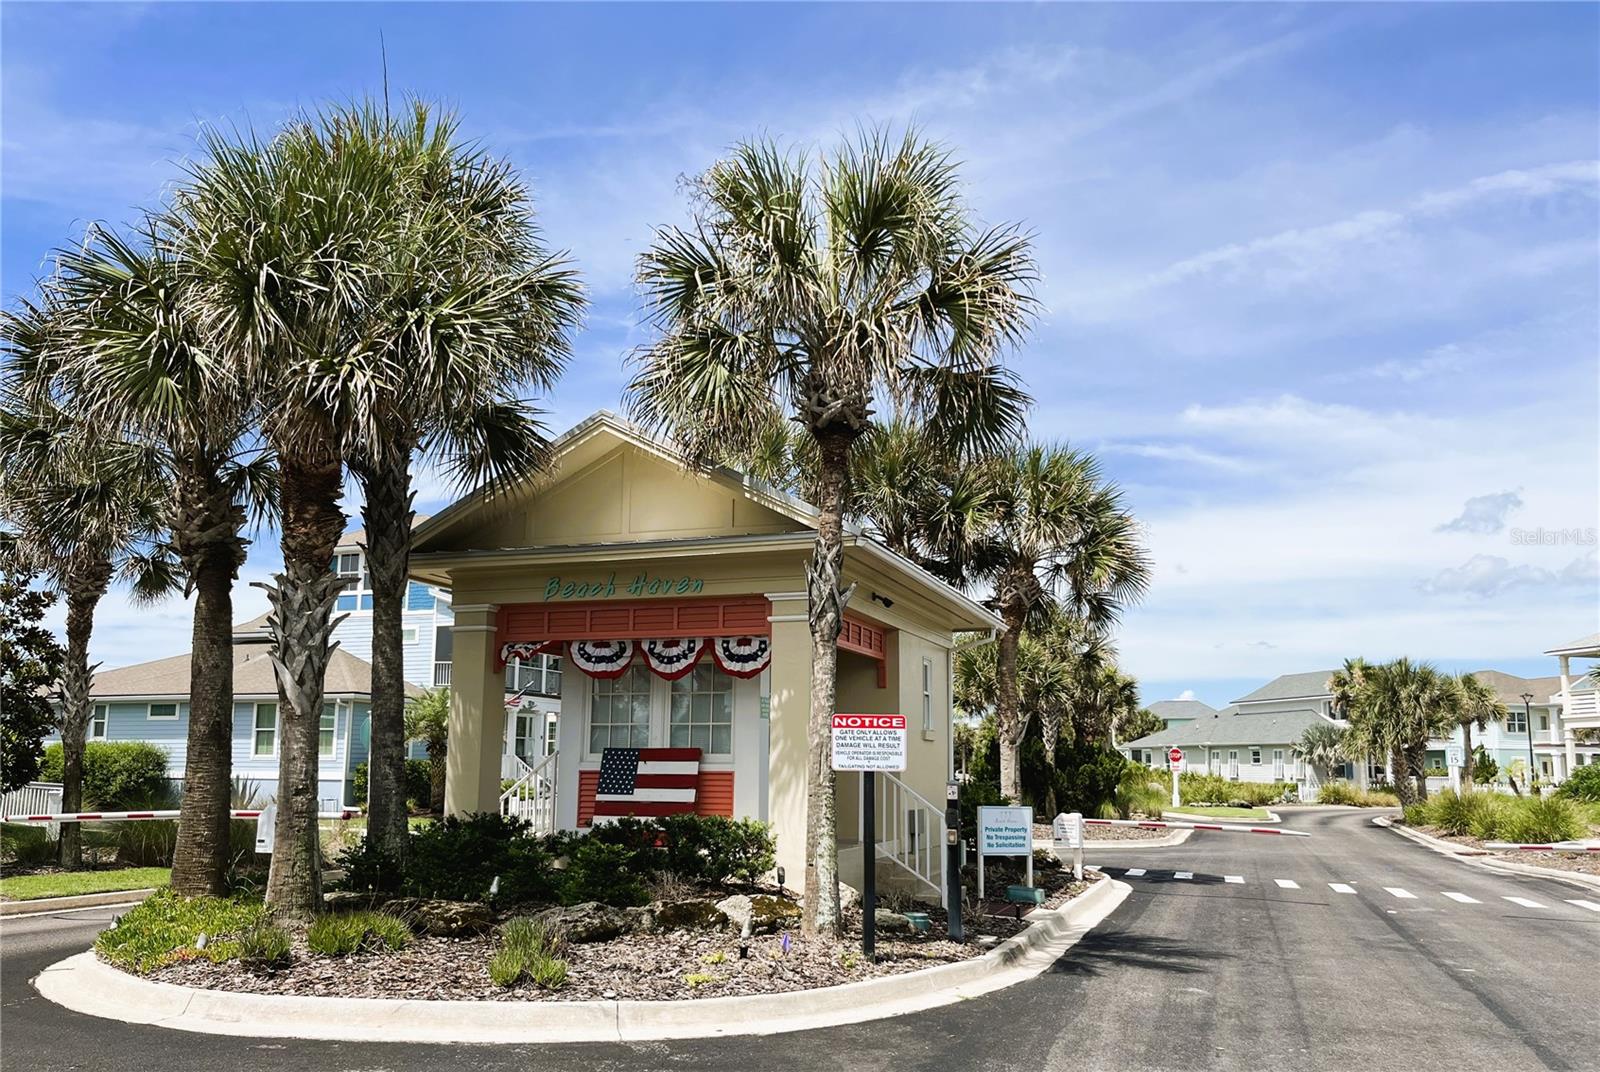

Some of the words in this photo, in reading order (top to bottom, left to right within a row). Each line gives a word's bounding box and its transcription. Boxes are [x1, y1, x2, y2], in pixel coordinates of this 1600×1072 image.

[544, 571, 616, 601] Beach
[626, 571, 704, 596] Haven
[834, 717, 904, 727] NOTICE
